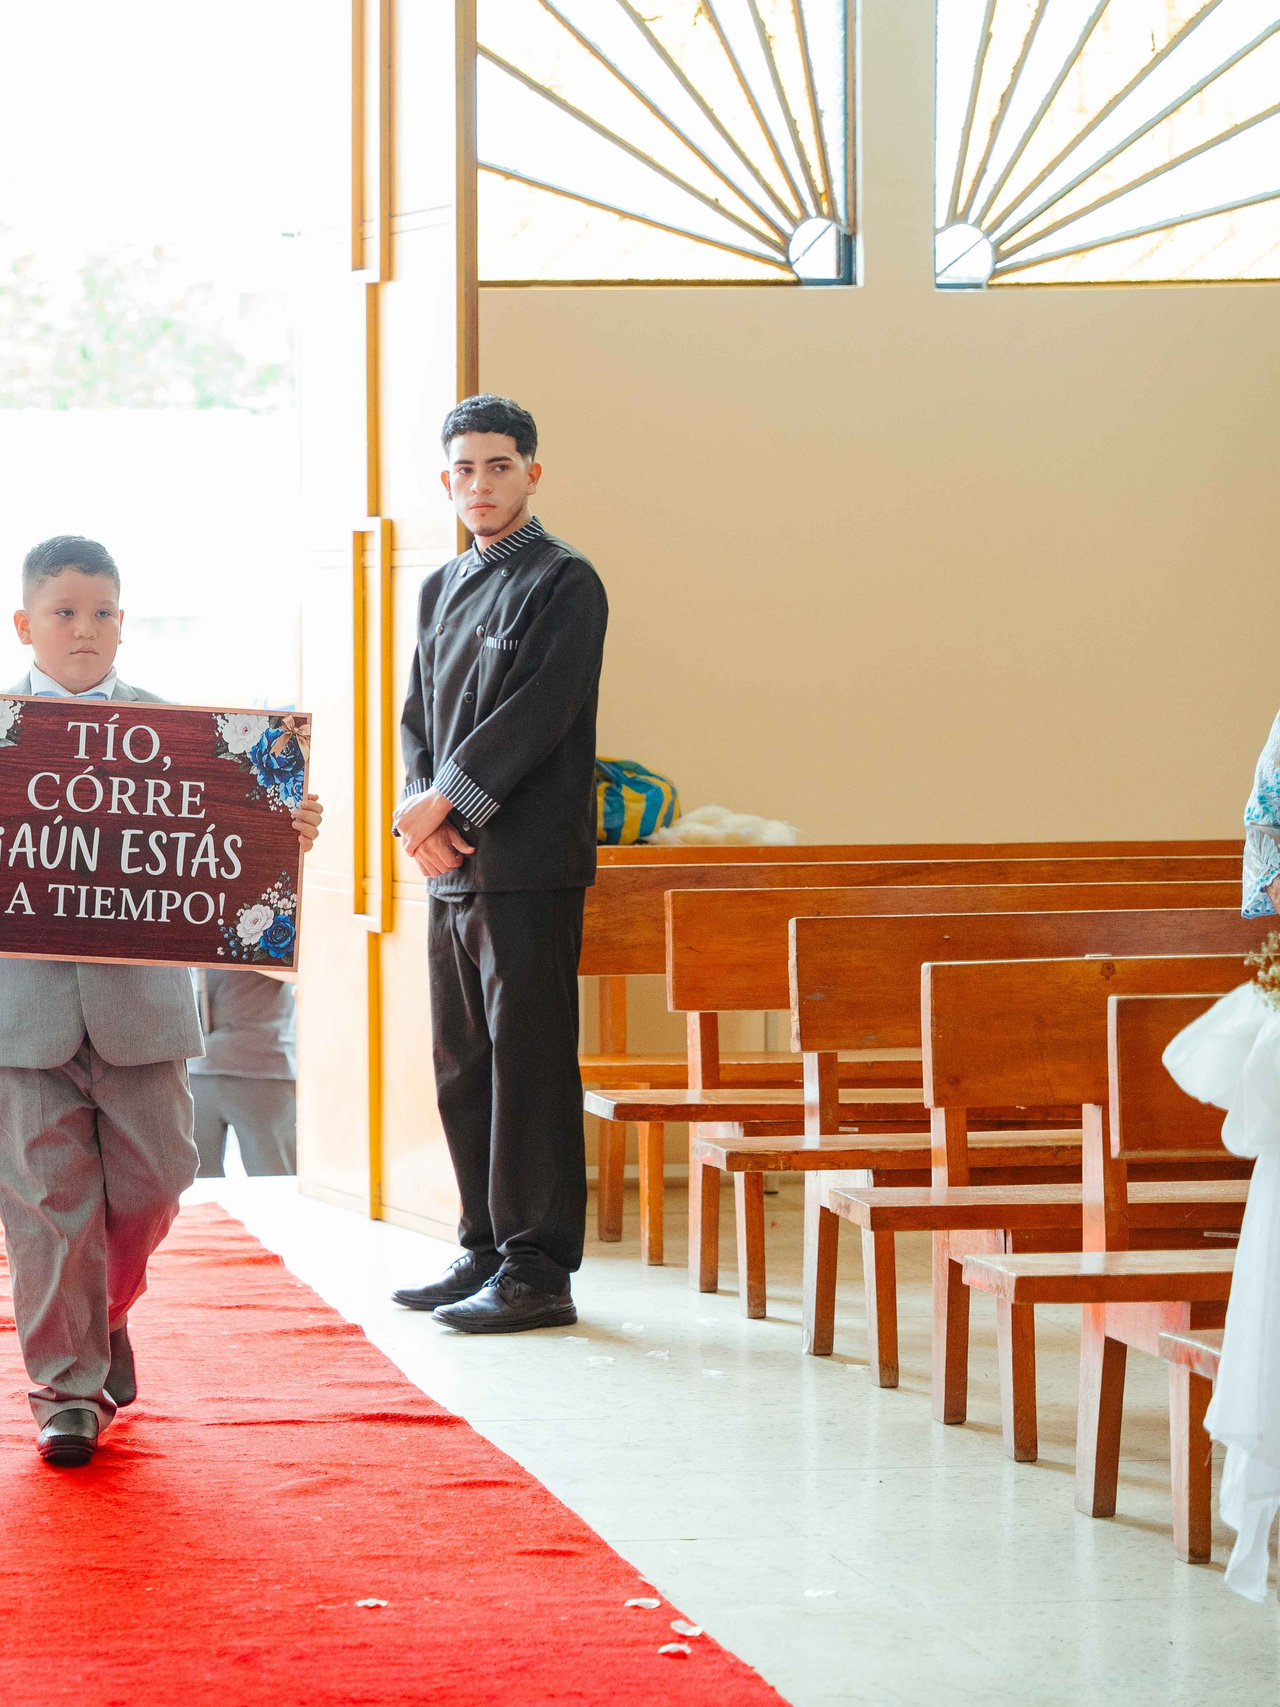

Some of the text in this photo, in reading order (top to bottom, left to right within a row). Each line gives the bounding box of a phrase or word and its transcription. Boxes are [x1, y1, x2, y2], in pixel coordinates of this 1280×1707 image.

[67, 713, 172, 771] TÍO,
[27, 765, 206, 819] CÓRRE
[120, 823, 243, 880] ESTÁS
[4, 881, 226, 926] A TIEMPO!
